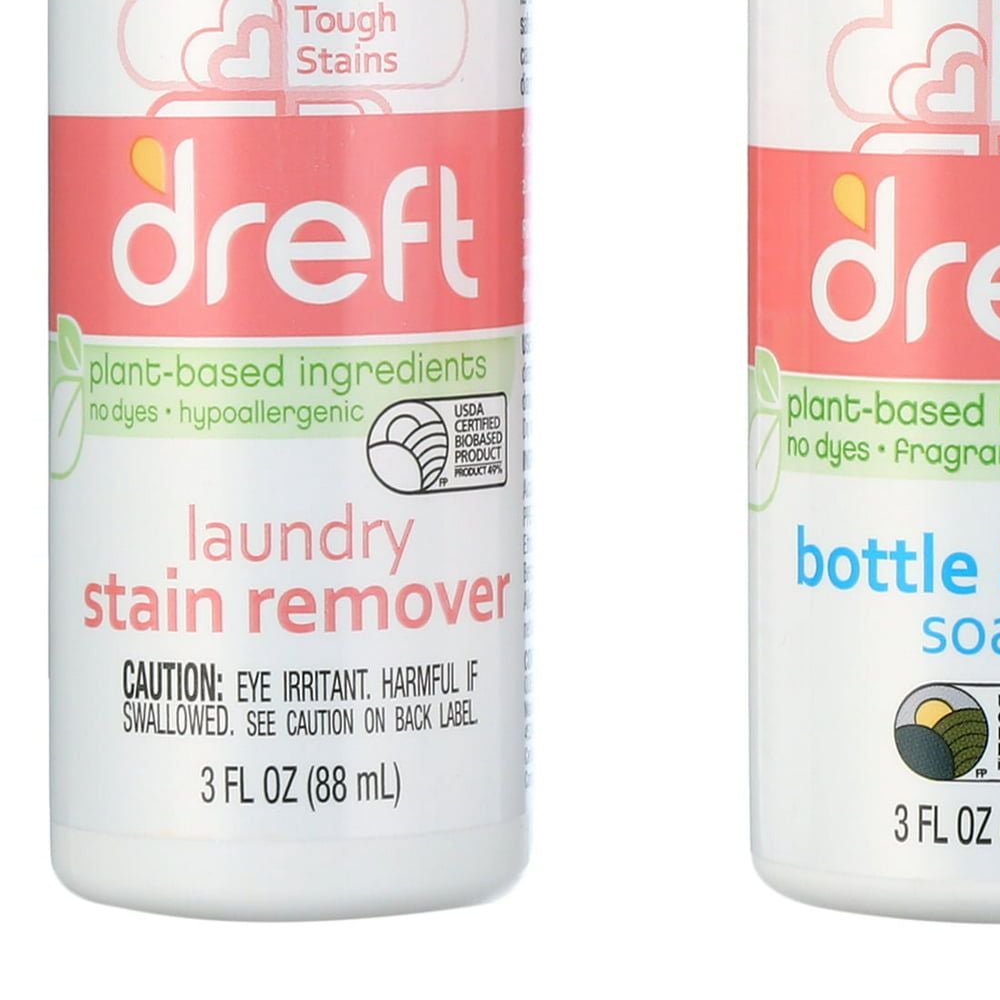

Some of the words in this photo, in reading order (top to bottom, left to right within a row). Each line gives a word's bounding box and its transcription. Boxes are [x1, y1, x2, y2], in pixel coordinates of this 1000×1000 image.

[294, 5, 397, 41] Tough
[296, 46, 398, 74] Stains
[112, 138, 479, 306] dreft
[89, 354, 285, 390] plant-based
[300, 353, 487, 396] ingredients
[89, 401, 110, 421] no
[112, 400, 159, 428] dyes
[179, 400, 364, 431] hypoallergenic
[454, 402, 484, 417] USDA
[454, 416, 500, 432] CERTIFIED
[787, 387, 985, 427] plant-based
[454, 446, 502, 463] PRODUCT
[455, 431, 503, 448] BIOBASED
[787, 434, 809, 457] no
[815, 432, 870, 468] dyes
[454, 466, 486, 478] PRODUCT
[188, 502, 415, 575] laundry
[796, 525, 978, 594] bottle
[83, 567, 224, 633] stain
[248, 573, 510, 634] remover
[122, 660, 223, 701] CAUTION:
[237, 671, 272, 702] EYE
[283, 668, 371, 701] IRRITANT.
[381, 662, 459, 698] HARMFUL
[467, 660, 478, 691] IF
[122, 704, 235, 736] SWALLOWED.
[247, 710, 276, 736] SEE
[287, 708, 354, 736] CAUTION
[365, 708, 385, 733] ON
[395, 705, 432, 732] BACK
[439, 703, 478, 729] LABEL.
[201, 766, 216, 803] 3
[225, 766, 254, 803] FL
[263, 766, 298, 803] OZ
[307, 764, 347, 811] (88
[357, 761, 401, 807] mL)
[975, 769, 987, 778] FP
[894, 804, 908, 842] 3
[919, 805, 949, 844] FL
[957, 805, 993, 844] OZ
